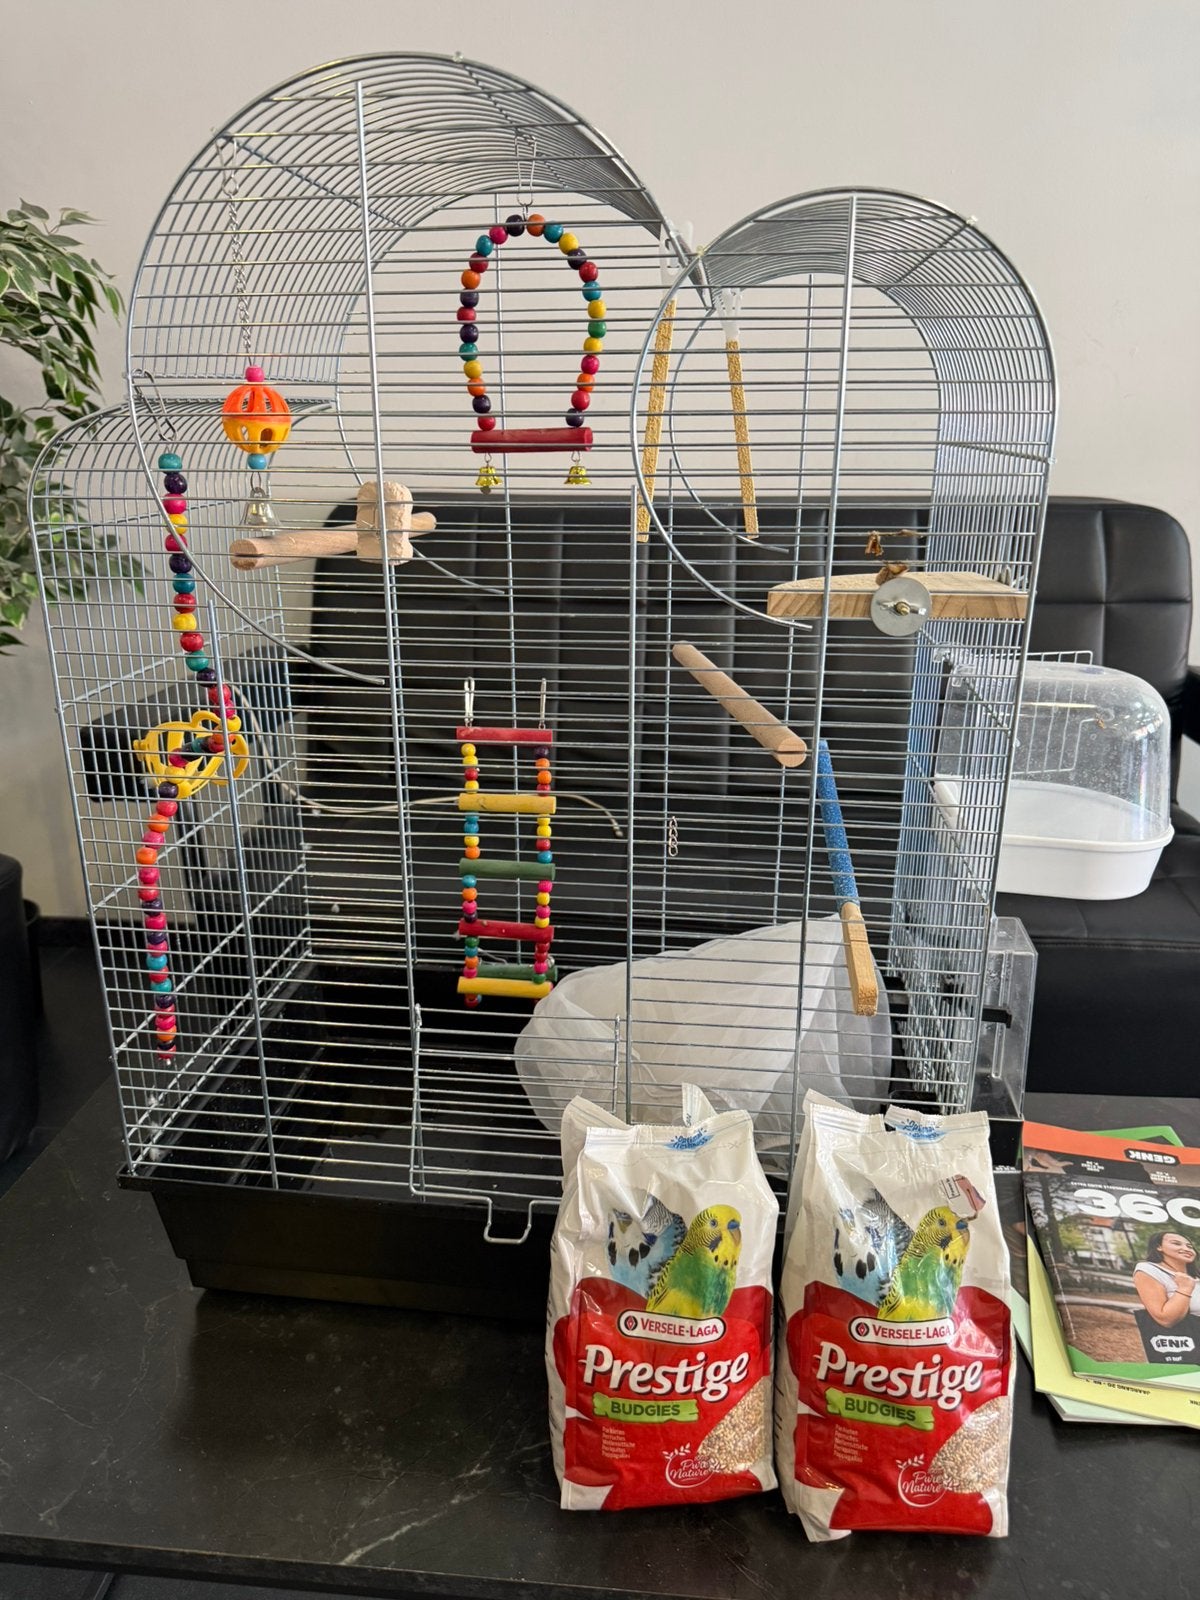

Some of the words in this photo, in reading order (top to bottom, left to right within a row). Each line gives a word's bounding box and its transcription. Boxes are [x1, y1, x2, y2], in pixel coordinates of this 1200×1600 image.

[1127, 1150, 1176, 1164] GENK
[640, 1317, 719, 1338] VERSELE-LAGA
[873, 1322, 952, 1340] VERSELE-LAGA
[1155, 1338, 1190, 1348] GENK
[578, 1344, 750, 1403] Prestige
[813, 1341, 983, 1411] Prestige
[610, 1401, 681, 1417] BUDGIES
[844, 1396, 917, 1421] BUDGIES
[670, 1468, 709, 1479] Nature
[912, 1470, 942, 1483] Pure
[902, 1480, 941, 1494] Nature
